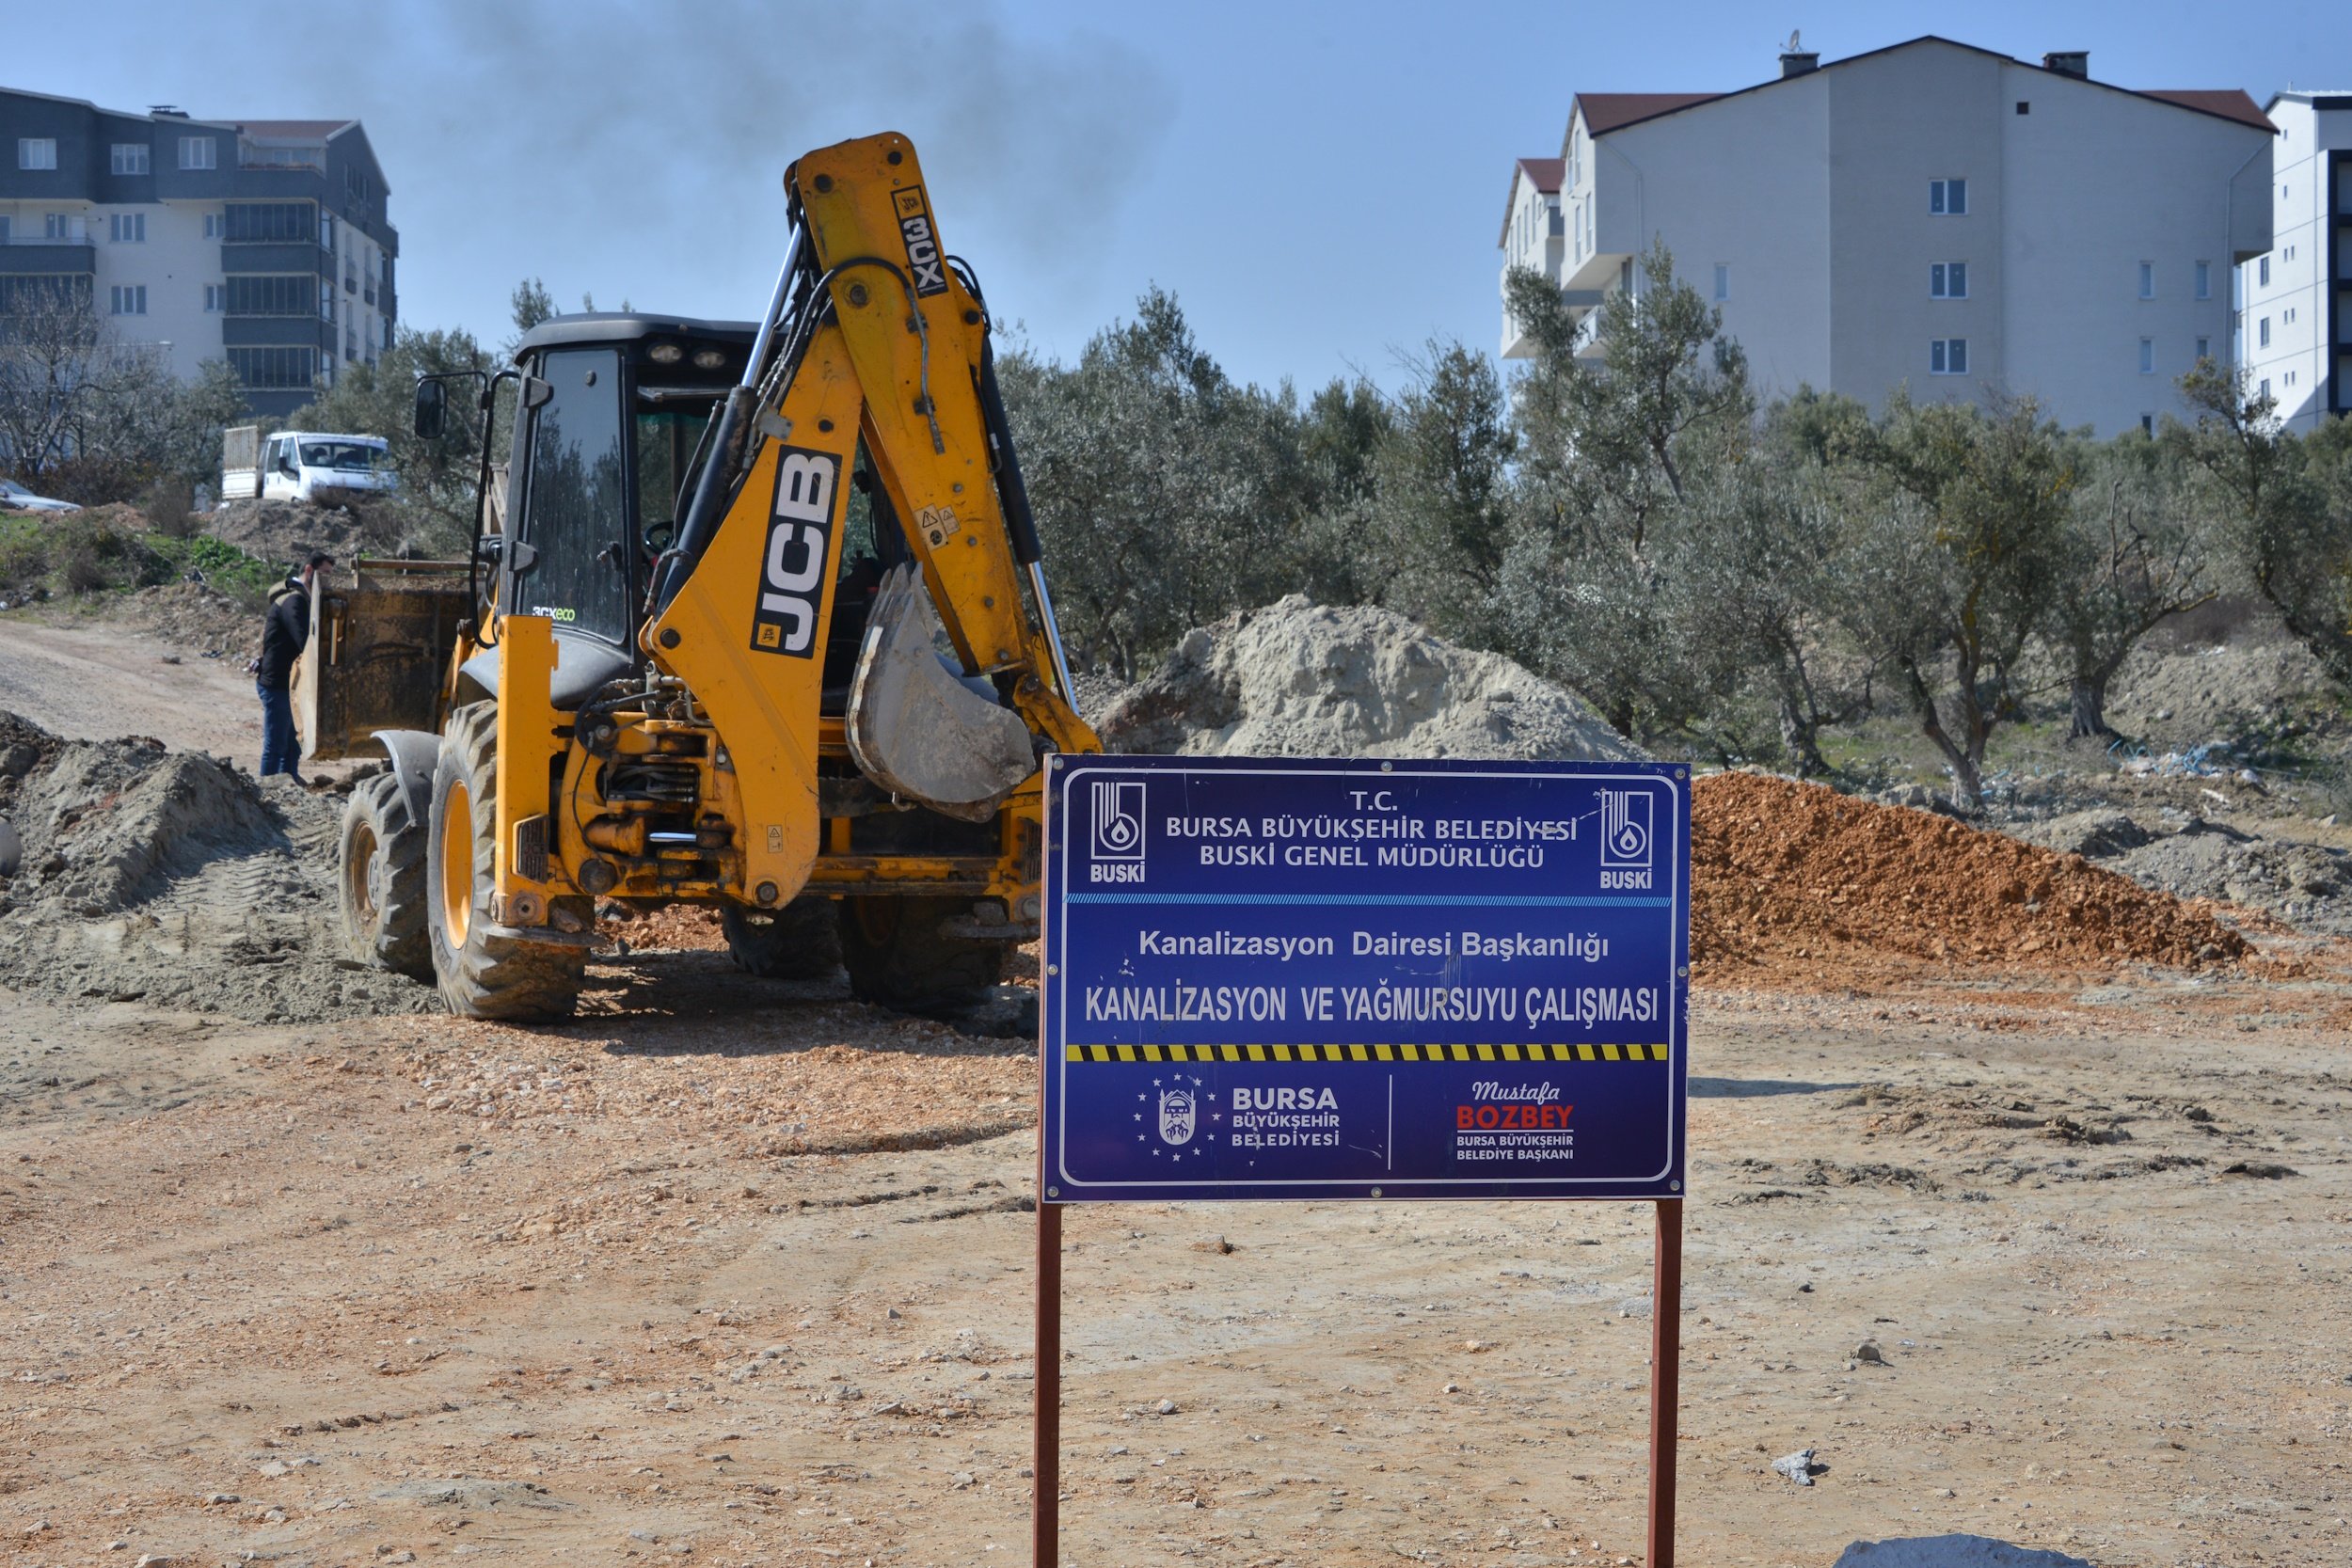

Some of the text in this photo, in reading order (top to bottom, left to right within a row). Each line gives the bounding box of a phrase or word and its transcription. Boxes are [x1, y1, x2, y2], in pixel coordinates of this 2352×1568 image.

[903, 217, 945, 288] 3CX
[761, 453, 834, 652] JCB
[1349, 791, 1398, 812] T.C.
[1167, 814, 1578, 843] BURSA BÜYÜKŞEHİR BELEDİYESİ
[1200, 843, 1544, 868] BUSKİ GENEL MÜDÜRLÜĞÜ
[1090, 861, 1146, 883] BUSKİ
[1600, 868, 1652, 890] BUSKİ
[1139, 930, 1609, 963] Kanalizasyon Dairesi Başkanlığı
[1086, 978, 1658, 1030] KANALİZASYON VE YAĞMURSUYU ÇALIŞMASI
[1232, 1087, 1339, 1111] BURSA
[1471, 1081, 1561, 1105] Mustafa
[1232, 1111, 1340, 1131] BÜYÜKŞEHİR
[1456, 1105, 1574, 1130] BOZBEY
[1232, 1131, 1340, 1147] BELEDİYESİ
[1456, 1133, 1574, 1148] BURSA BÜYÜKŞEHİR
[1456, 1148, 1574, 1163] BELEDİYE BAŞKANI
